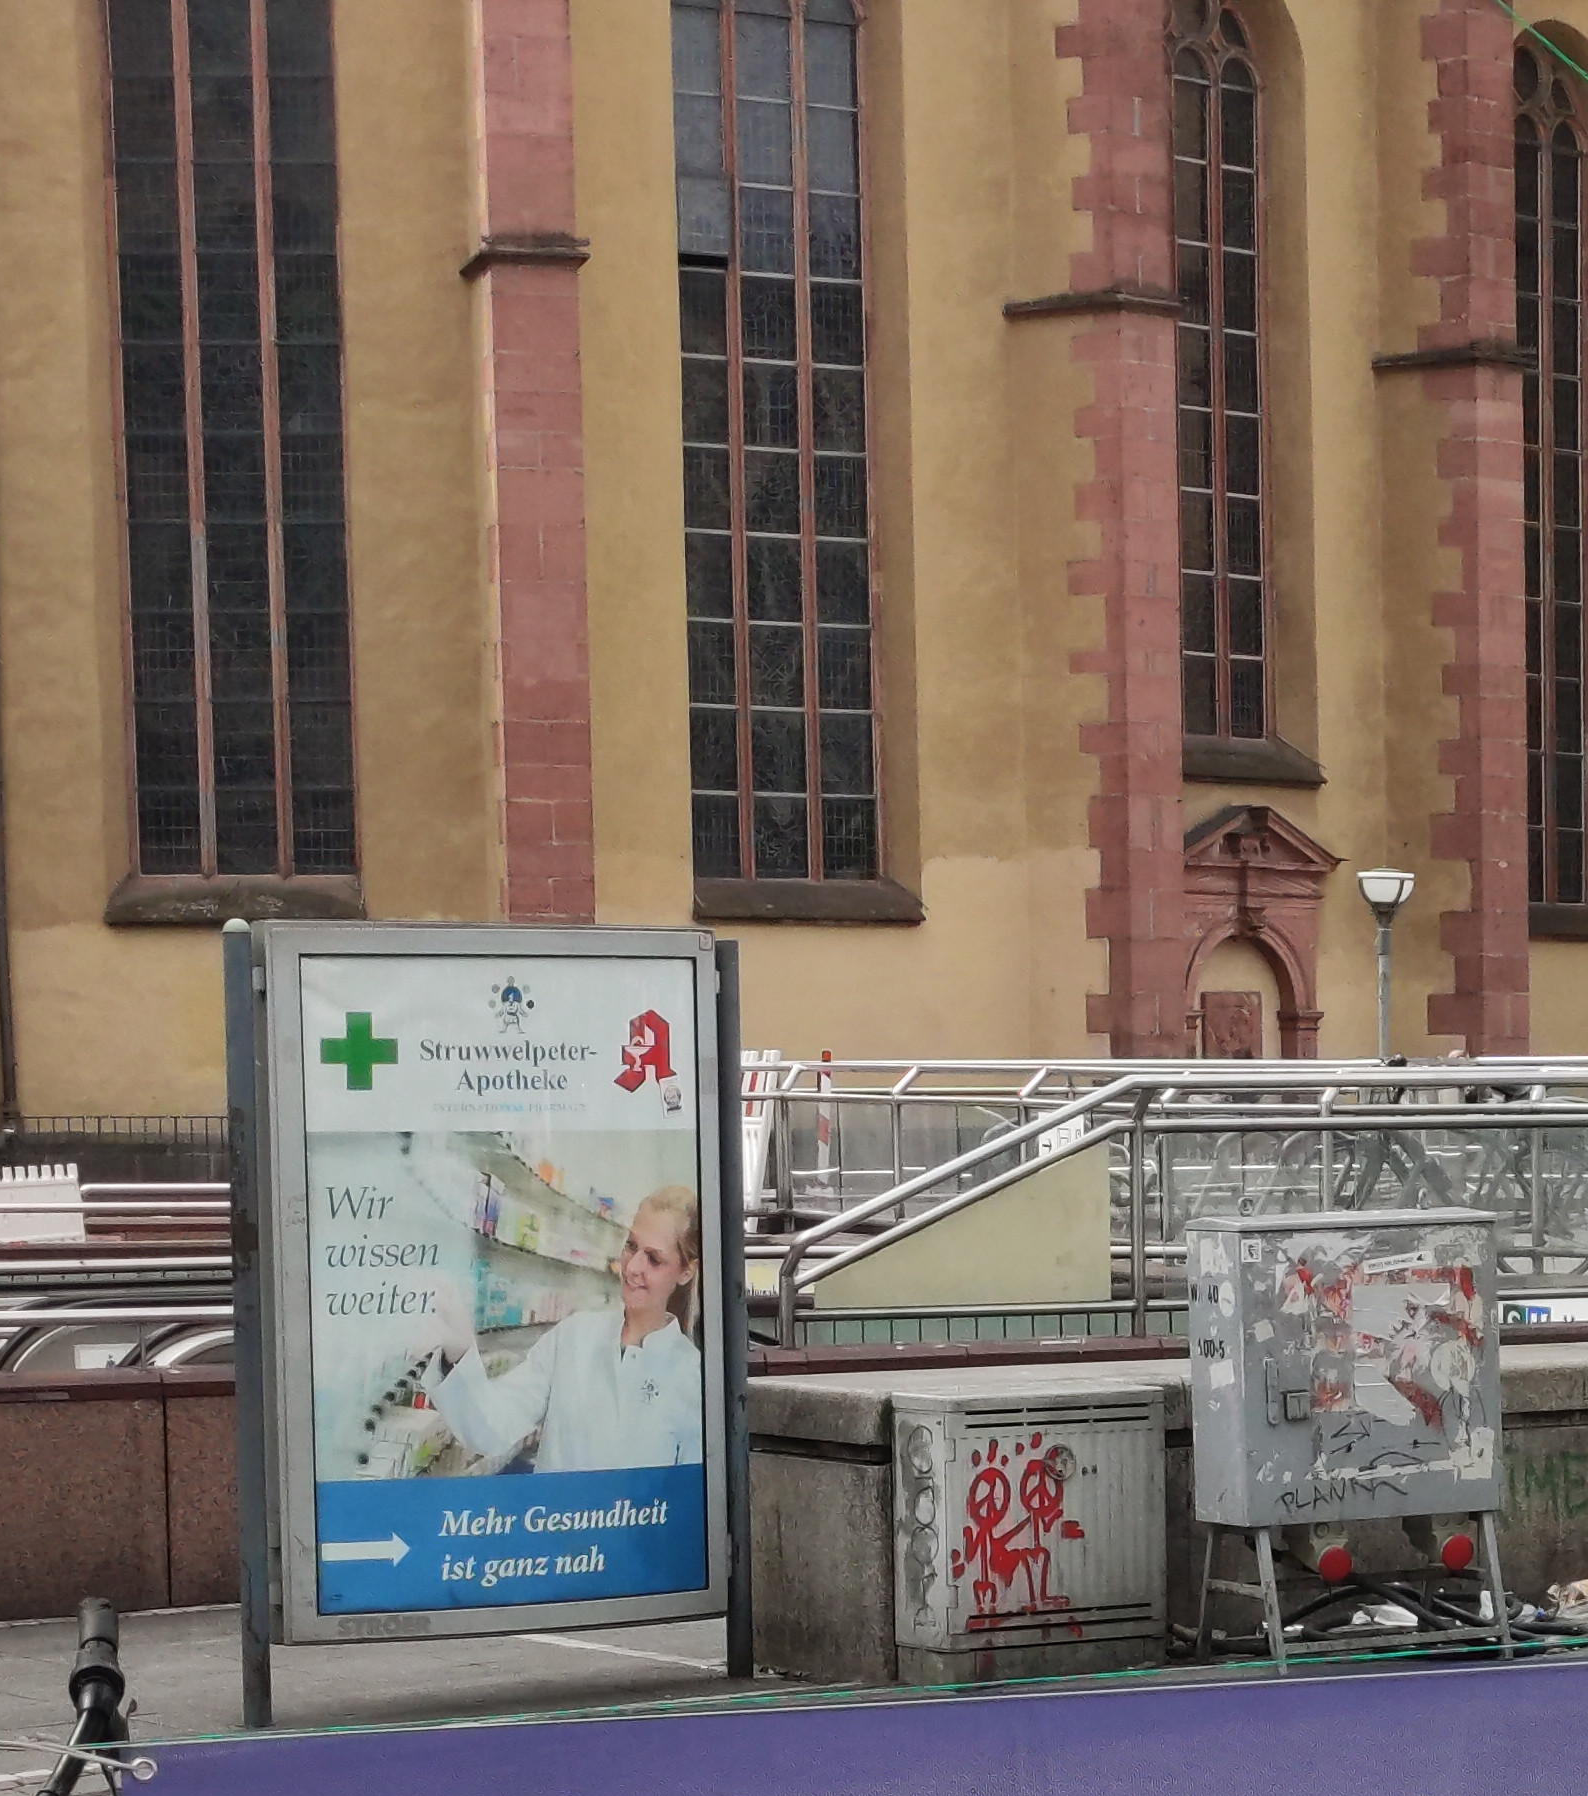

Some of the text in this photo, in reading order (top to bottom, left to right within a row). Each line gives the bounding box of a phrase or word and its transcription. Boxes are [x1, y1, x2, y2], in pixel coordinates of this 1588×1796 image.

[419, 1039, 599, 1067] Struwwelpeter-
[457, 1069, 569, 1097] Apotheke
[326, 1184, 394, 1222] Wir
[325, 1237, 439, 1270] wissen
[325, 1281, 438, 1318] weiter.
[438, 1498, 669, 1538] Mehr Gesundheit
[440, 1544, 606, 1588] ist ganz nah
